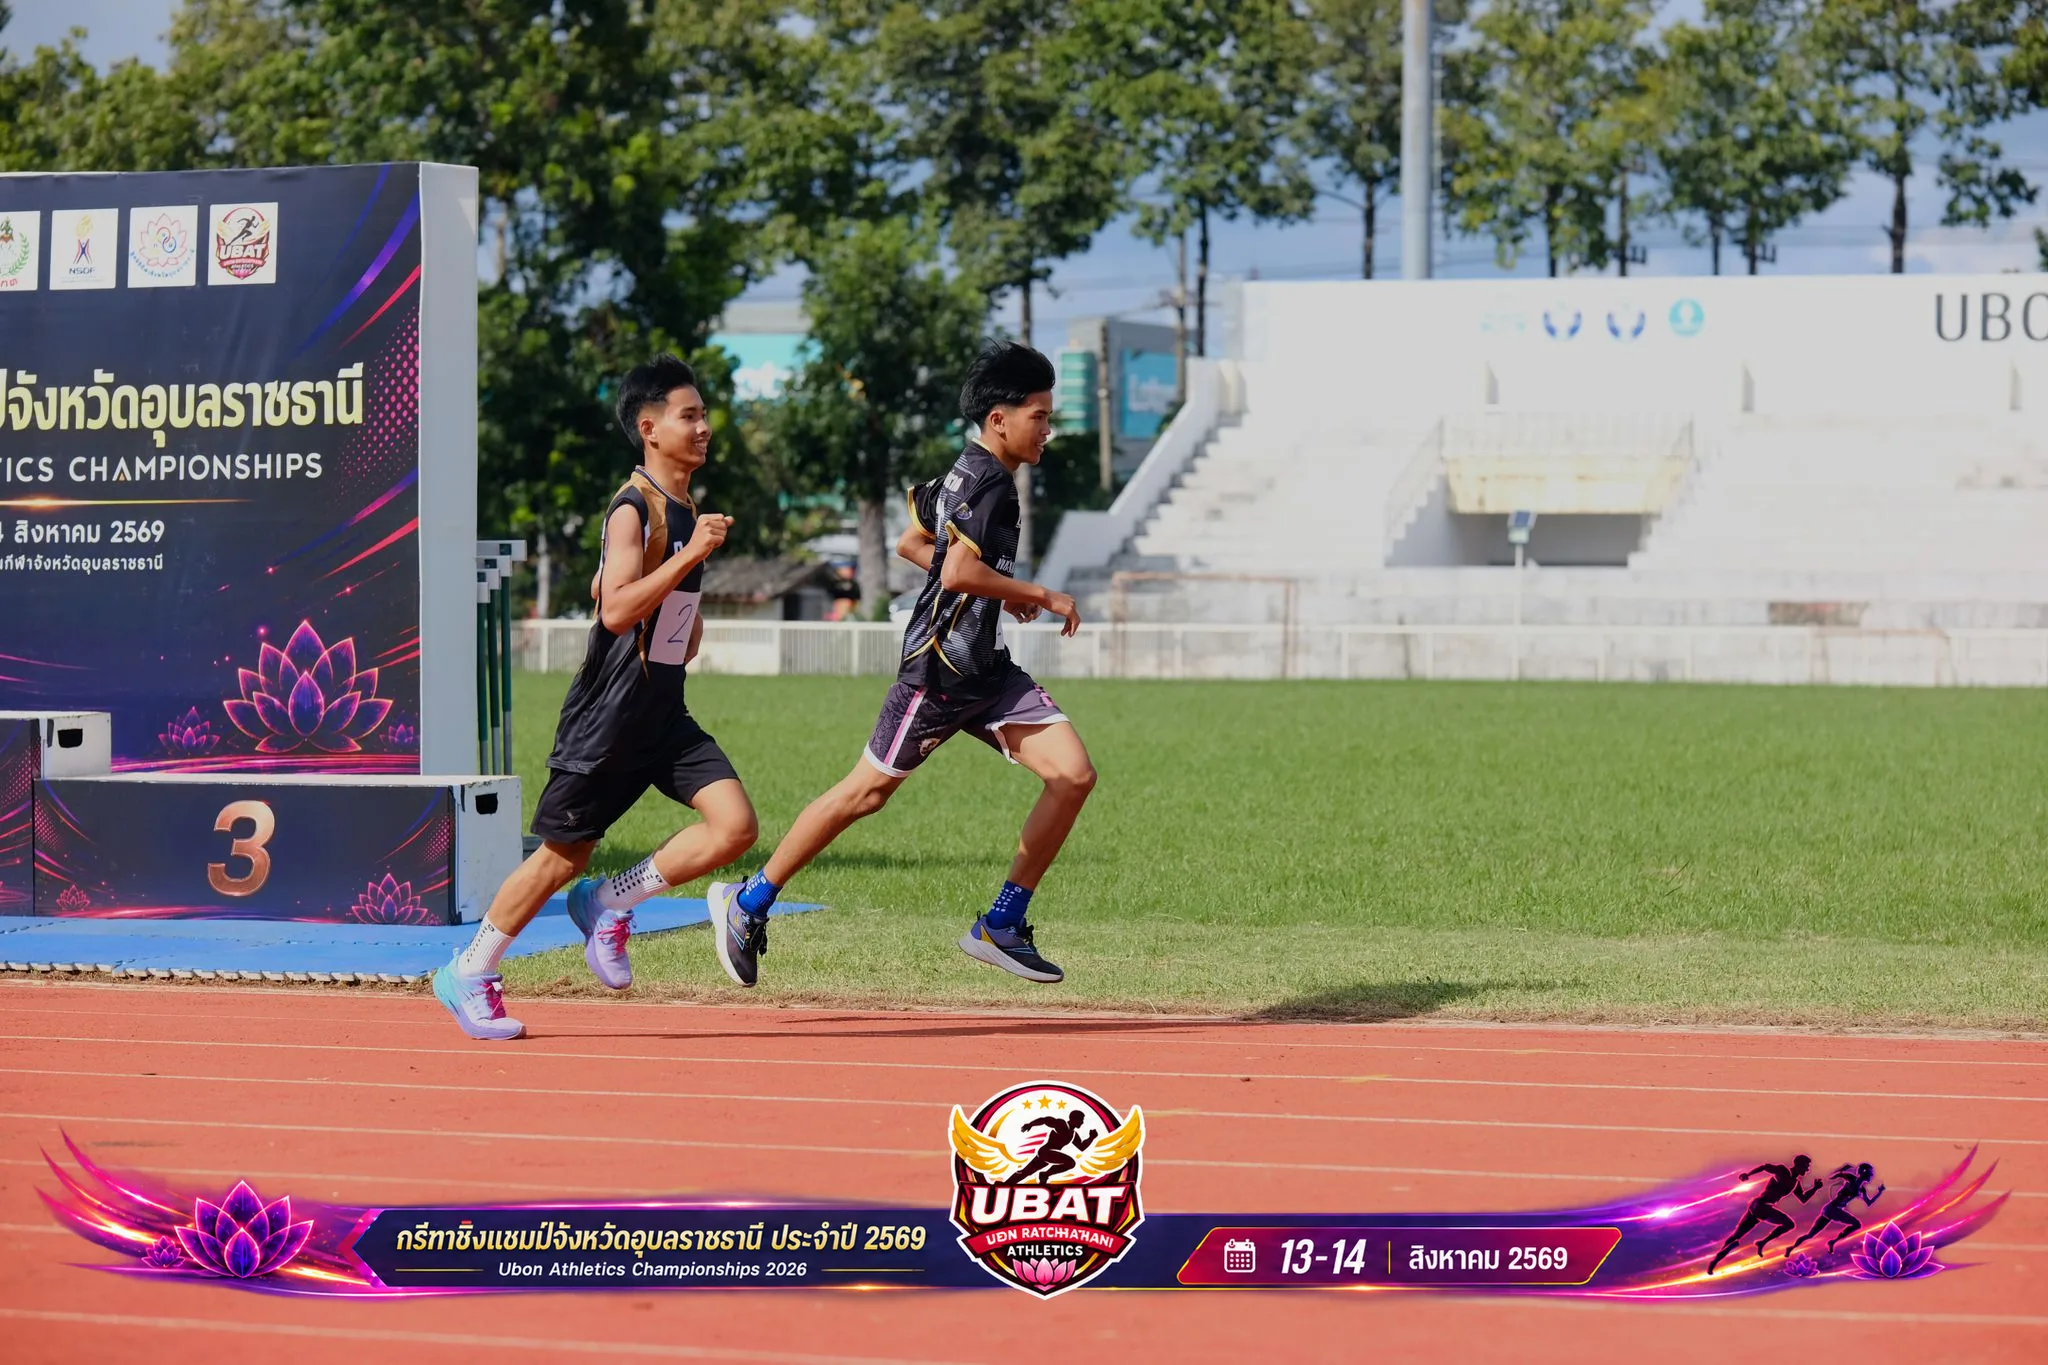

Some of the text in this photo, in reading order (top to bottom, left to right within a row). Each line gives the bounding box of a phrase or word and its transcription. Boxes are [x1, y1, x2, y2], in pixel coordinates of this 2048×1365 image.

[220, 243, 267, 260] UBAT
[0, 362, 364, 448] จังหวัดอุบลราชธานี
[0, 452, 323, 483] ICS CHAMPIONSHIPS
[14, 519, 101, 544] สิงหาคม
[110, 520, 165, 543] 2569
[667, 603, 692, 644] 2
[207, 799, 276, 897] 3
